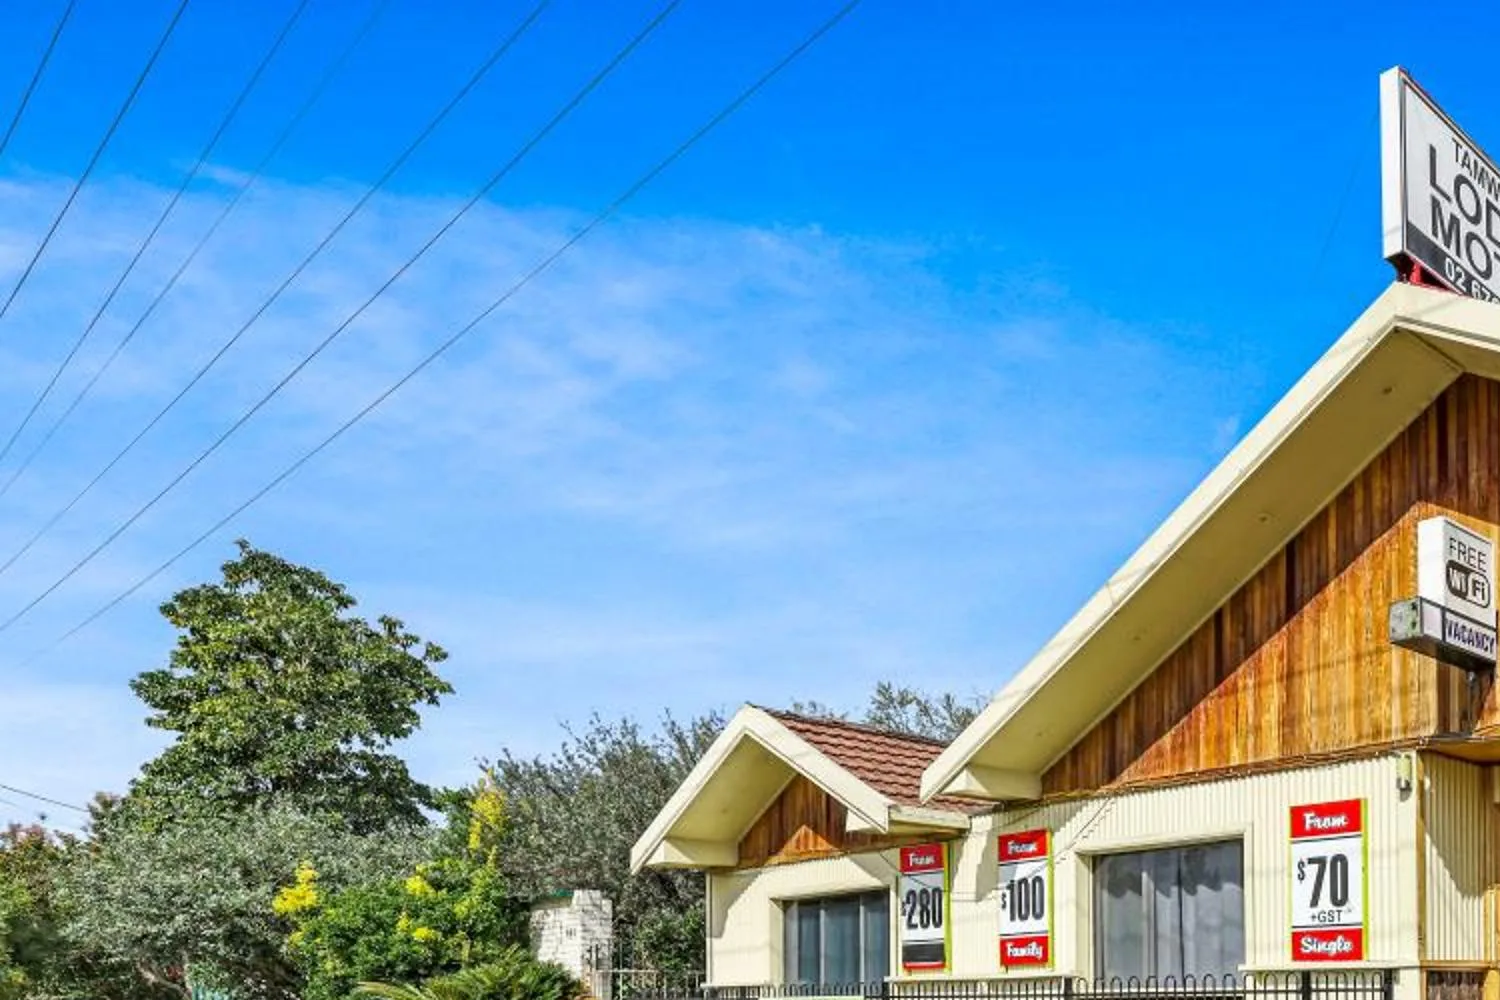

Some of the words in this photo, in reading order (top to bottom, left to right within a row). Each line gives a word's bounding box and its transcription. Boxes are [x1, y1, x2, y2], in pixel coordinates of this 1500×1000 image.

[1445, 258, 1466, 292] 02
[1449, 537, 1487, 573] FREE
[1446, 617, 1495, 653] VACANCY
[1303, 811, 1348, 832] From
[908, 853, 935, 867] From
[1007, 840, 1038, 856] From
[1297, 853, 1349, 908] $70
[901, 886, 943, 929] $280
[1001, 875, 1045, 922] $100
[1310, 909, 1343, 923] +GST
[1006, 941, 1043, 960] Family
[1301, 934, 1353, 956] Single
